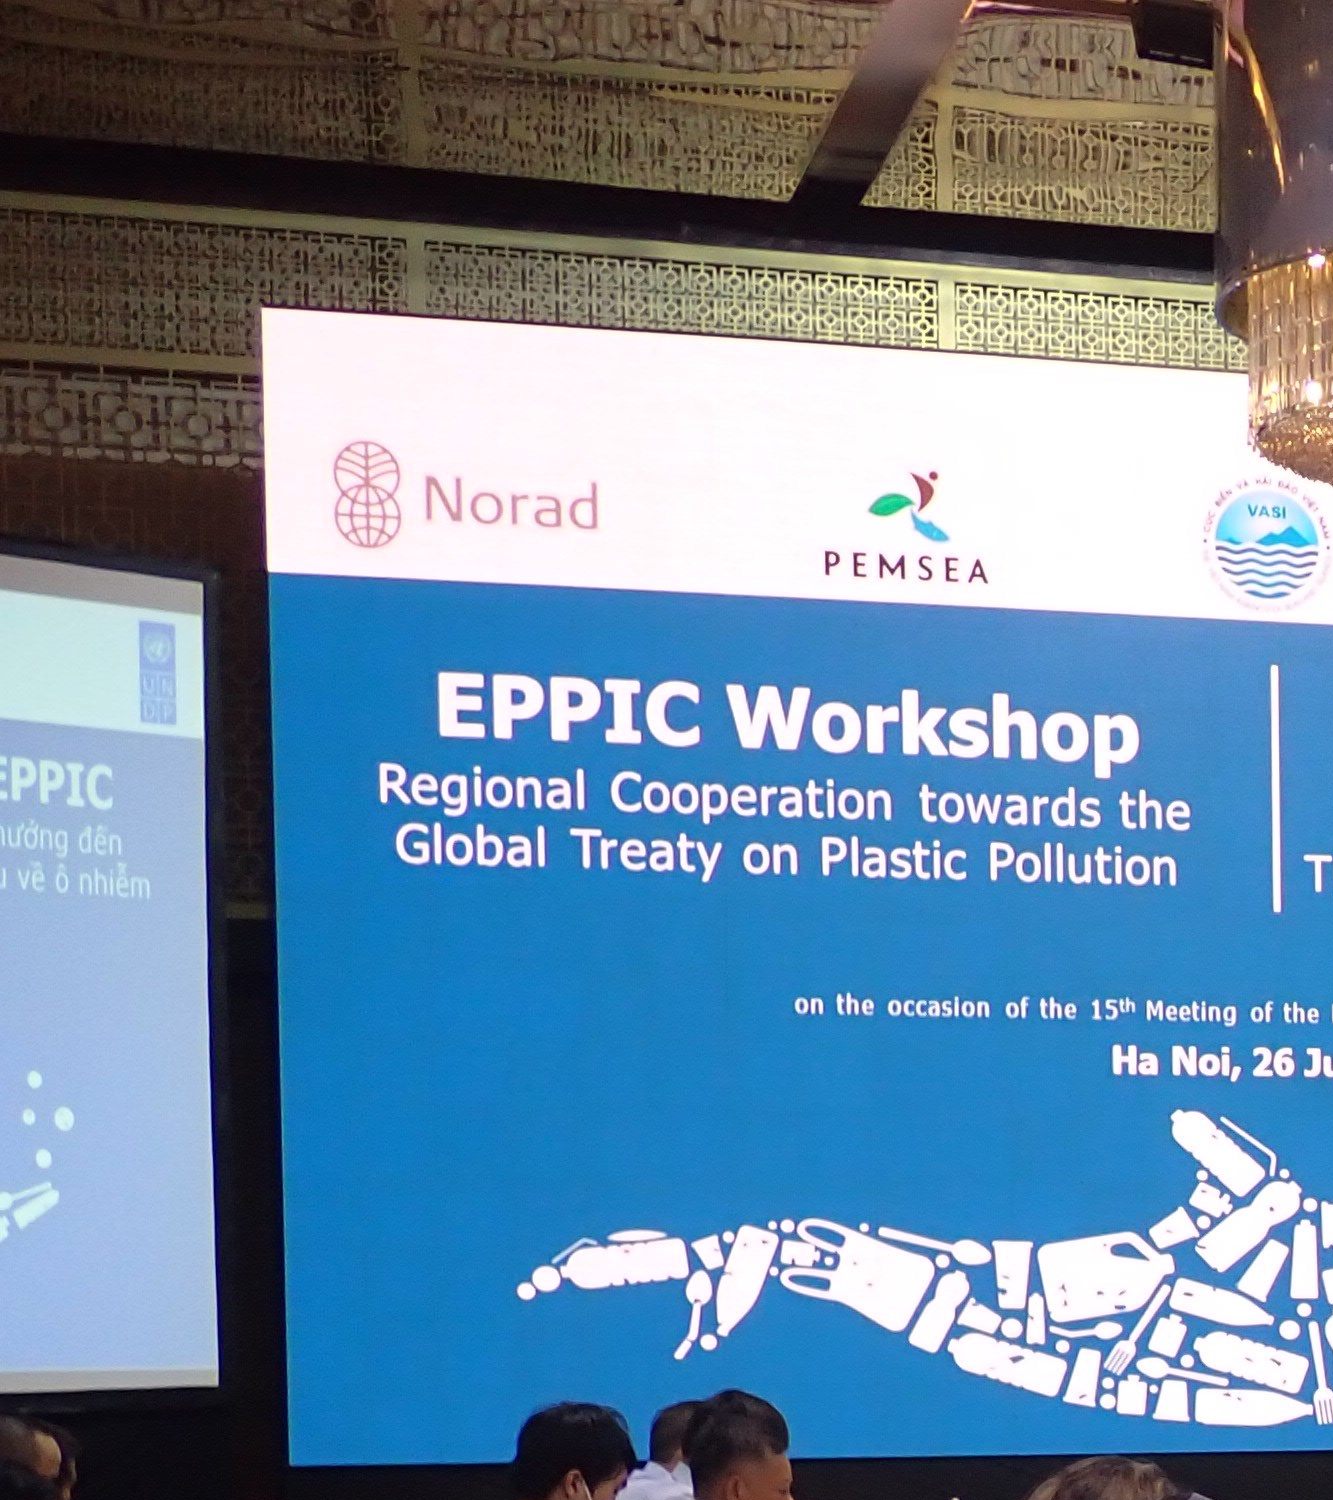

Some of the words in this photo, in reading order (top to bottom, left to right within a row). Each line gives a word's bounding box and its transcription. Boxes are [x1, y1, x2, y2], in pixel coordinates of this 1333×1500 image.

[423, 476, 599, 530] Norad
[1247, 504, 1287, 519] VASI
[824, 550, 988, 584] PEMSEA
[436, 669, 701, 747] EPPIC
[727, 683, 1141, 778] Workshop
[378, 762, 586, 816] Regional
[611, 770, 892, 825] Cooperation
[919, 780, 1101, 828] towards
[1120, 787, 1191, 832] the
[79, 824, 122, 855] đến
[397, 823, 547, 869] Global
[571, 826, 722, 884] Treaty
[743, 841, 798, 877] on
[821, 835, 967, 881] Plastic
[990, 841, 1178, 887] Pollution
[18, 860, 45, 892] về
[56, 863, 69, 894] ô
[79, 862, 150, 899] nhiễm
[794, 996, 825, 1015] on
[836, 993, 875, 1016] the
[887, 996, 990, 1018] occasion
[1005, 996, 1029, 1020] of
[1040, 996, 1077, 1020] the
[1091, 997, 1136, 1021] 15th
[1146, 999, 1237, 1027] Meeting
[1250, 1000, 1274, 1023] of
[1283, 1001, 1320, 1025] the
[1111, 1044, 1158, 1076] Ha
[1171, 1045, 1242, 1083] Noi,
[1252, 1047, 1295, 1077] 26
